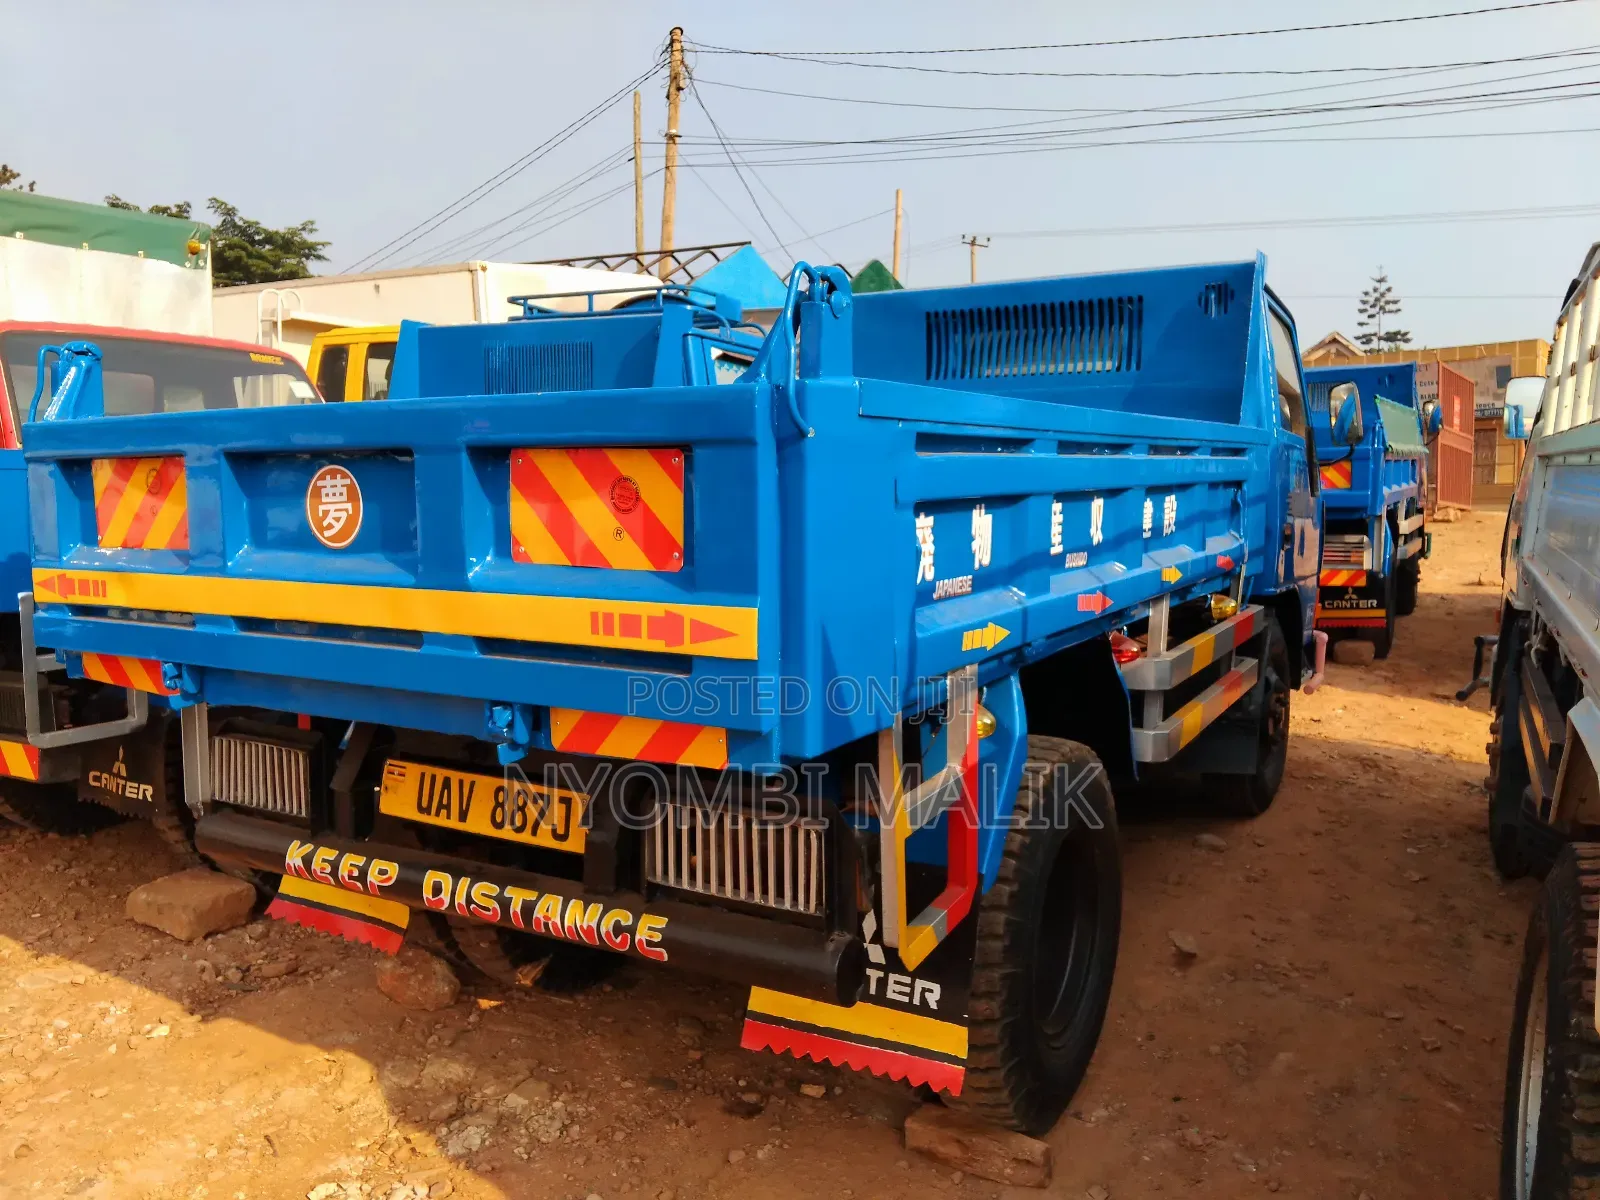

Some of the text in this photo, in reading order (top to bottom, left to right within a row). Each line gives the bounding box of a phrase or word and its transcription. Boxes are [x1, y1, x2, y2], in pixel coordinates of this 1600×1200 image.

[316, 473, 353, 538] 夢
[933, 575, 973, 600] JAPANESE
[1325, 599, 1378, 609] CANTER
[88, 770, 153, 802] CANTER
[416, 771, 573, 843] UAV 887J
[285, 839, 669, 962] KEEP DISTANCE
[865, 967, 941, 1010] TER
